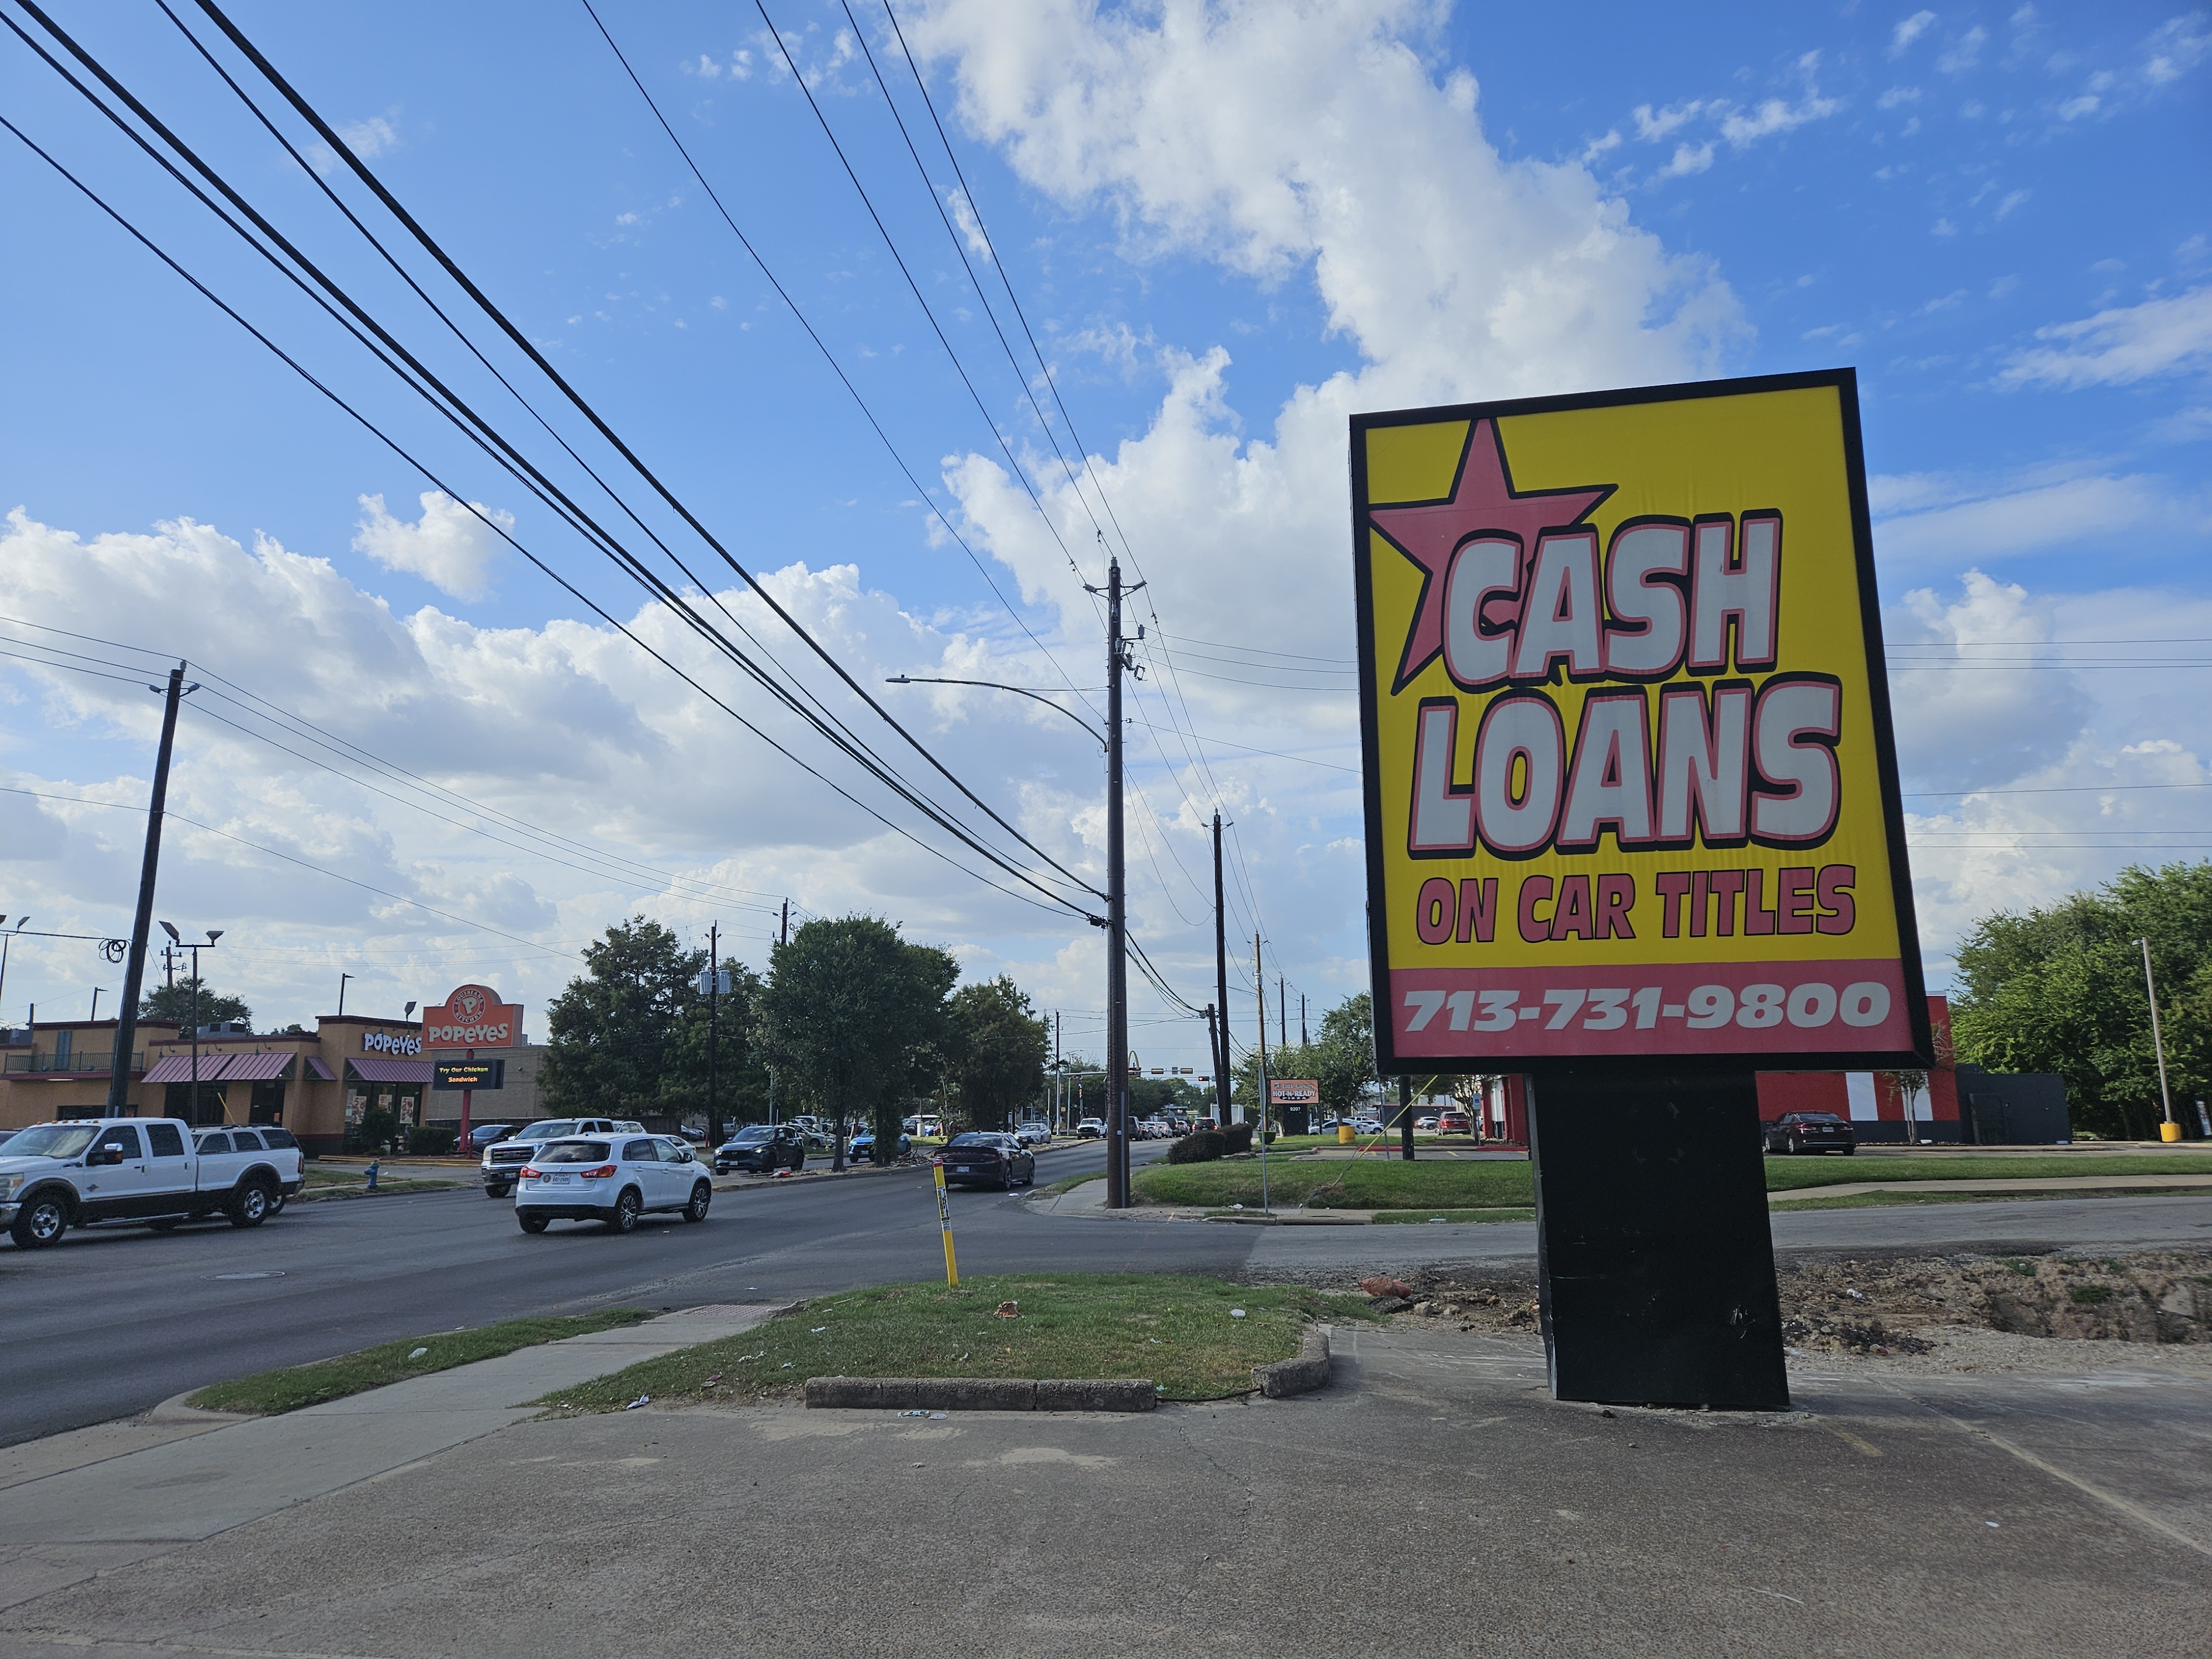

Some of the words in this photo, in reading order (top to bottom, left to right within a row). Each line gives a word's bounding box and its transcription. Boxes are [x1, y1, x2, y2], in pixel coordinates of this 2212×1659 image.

[1442, 508, 1783, 694] CASH
[1407, 671, 1843, 861] LOANS
[1416, 877, 1499, 945] ON
[1517, 873, 1636, 943] CAR
[1655, 864, 1856, 938] TITLES
[455, 989, 484, 1004] LOUISIANA
[455, 1010, 483, 1023] KITCHEN
[462, 997, 477, 1014] P
[1404, 981, 1891, 1032] 713-731-9800
